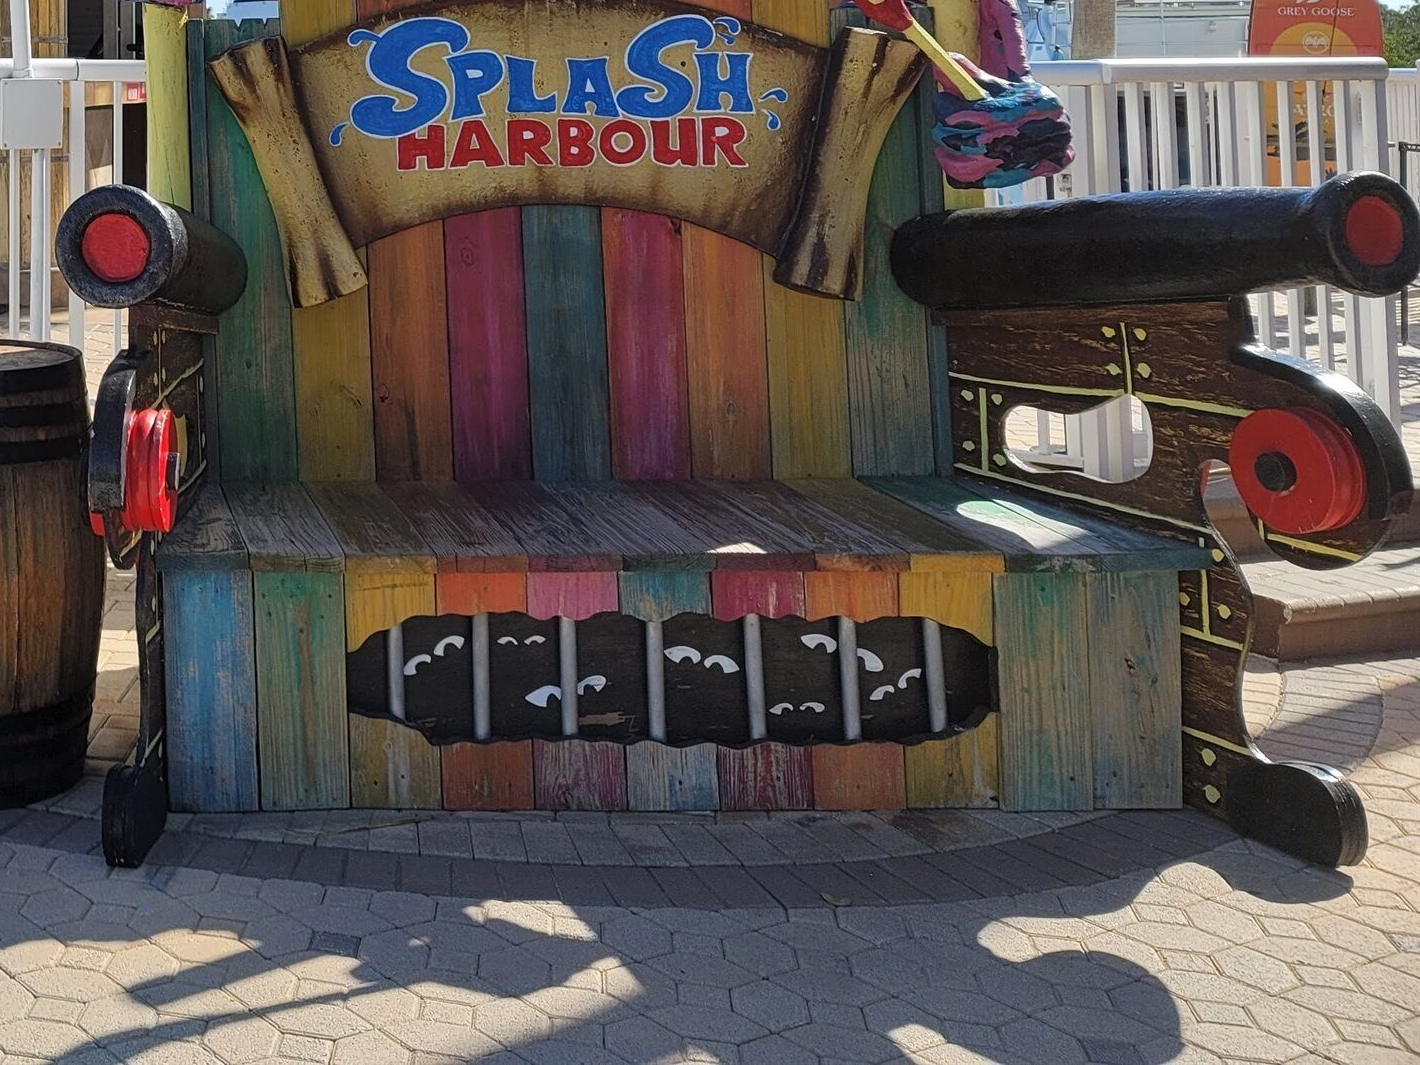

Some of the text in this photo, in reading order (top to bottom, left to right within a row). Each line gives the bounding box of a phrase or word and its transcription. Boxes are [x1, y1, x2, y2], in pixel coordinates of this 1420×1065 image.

[1277, 7, 1354, 17] GREY GOOSE
[350, 14, 755, 138] SPLASH
[396, 116, 749, 172] HARBOUR
